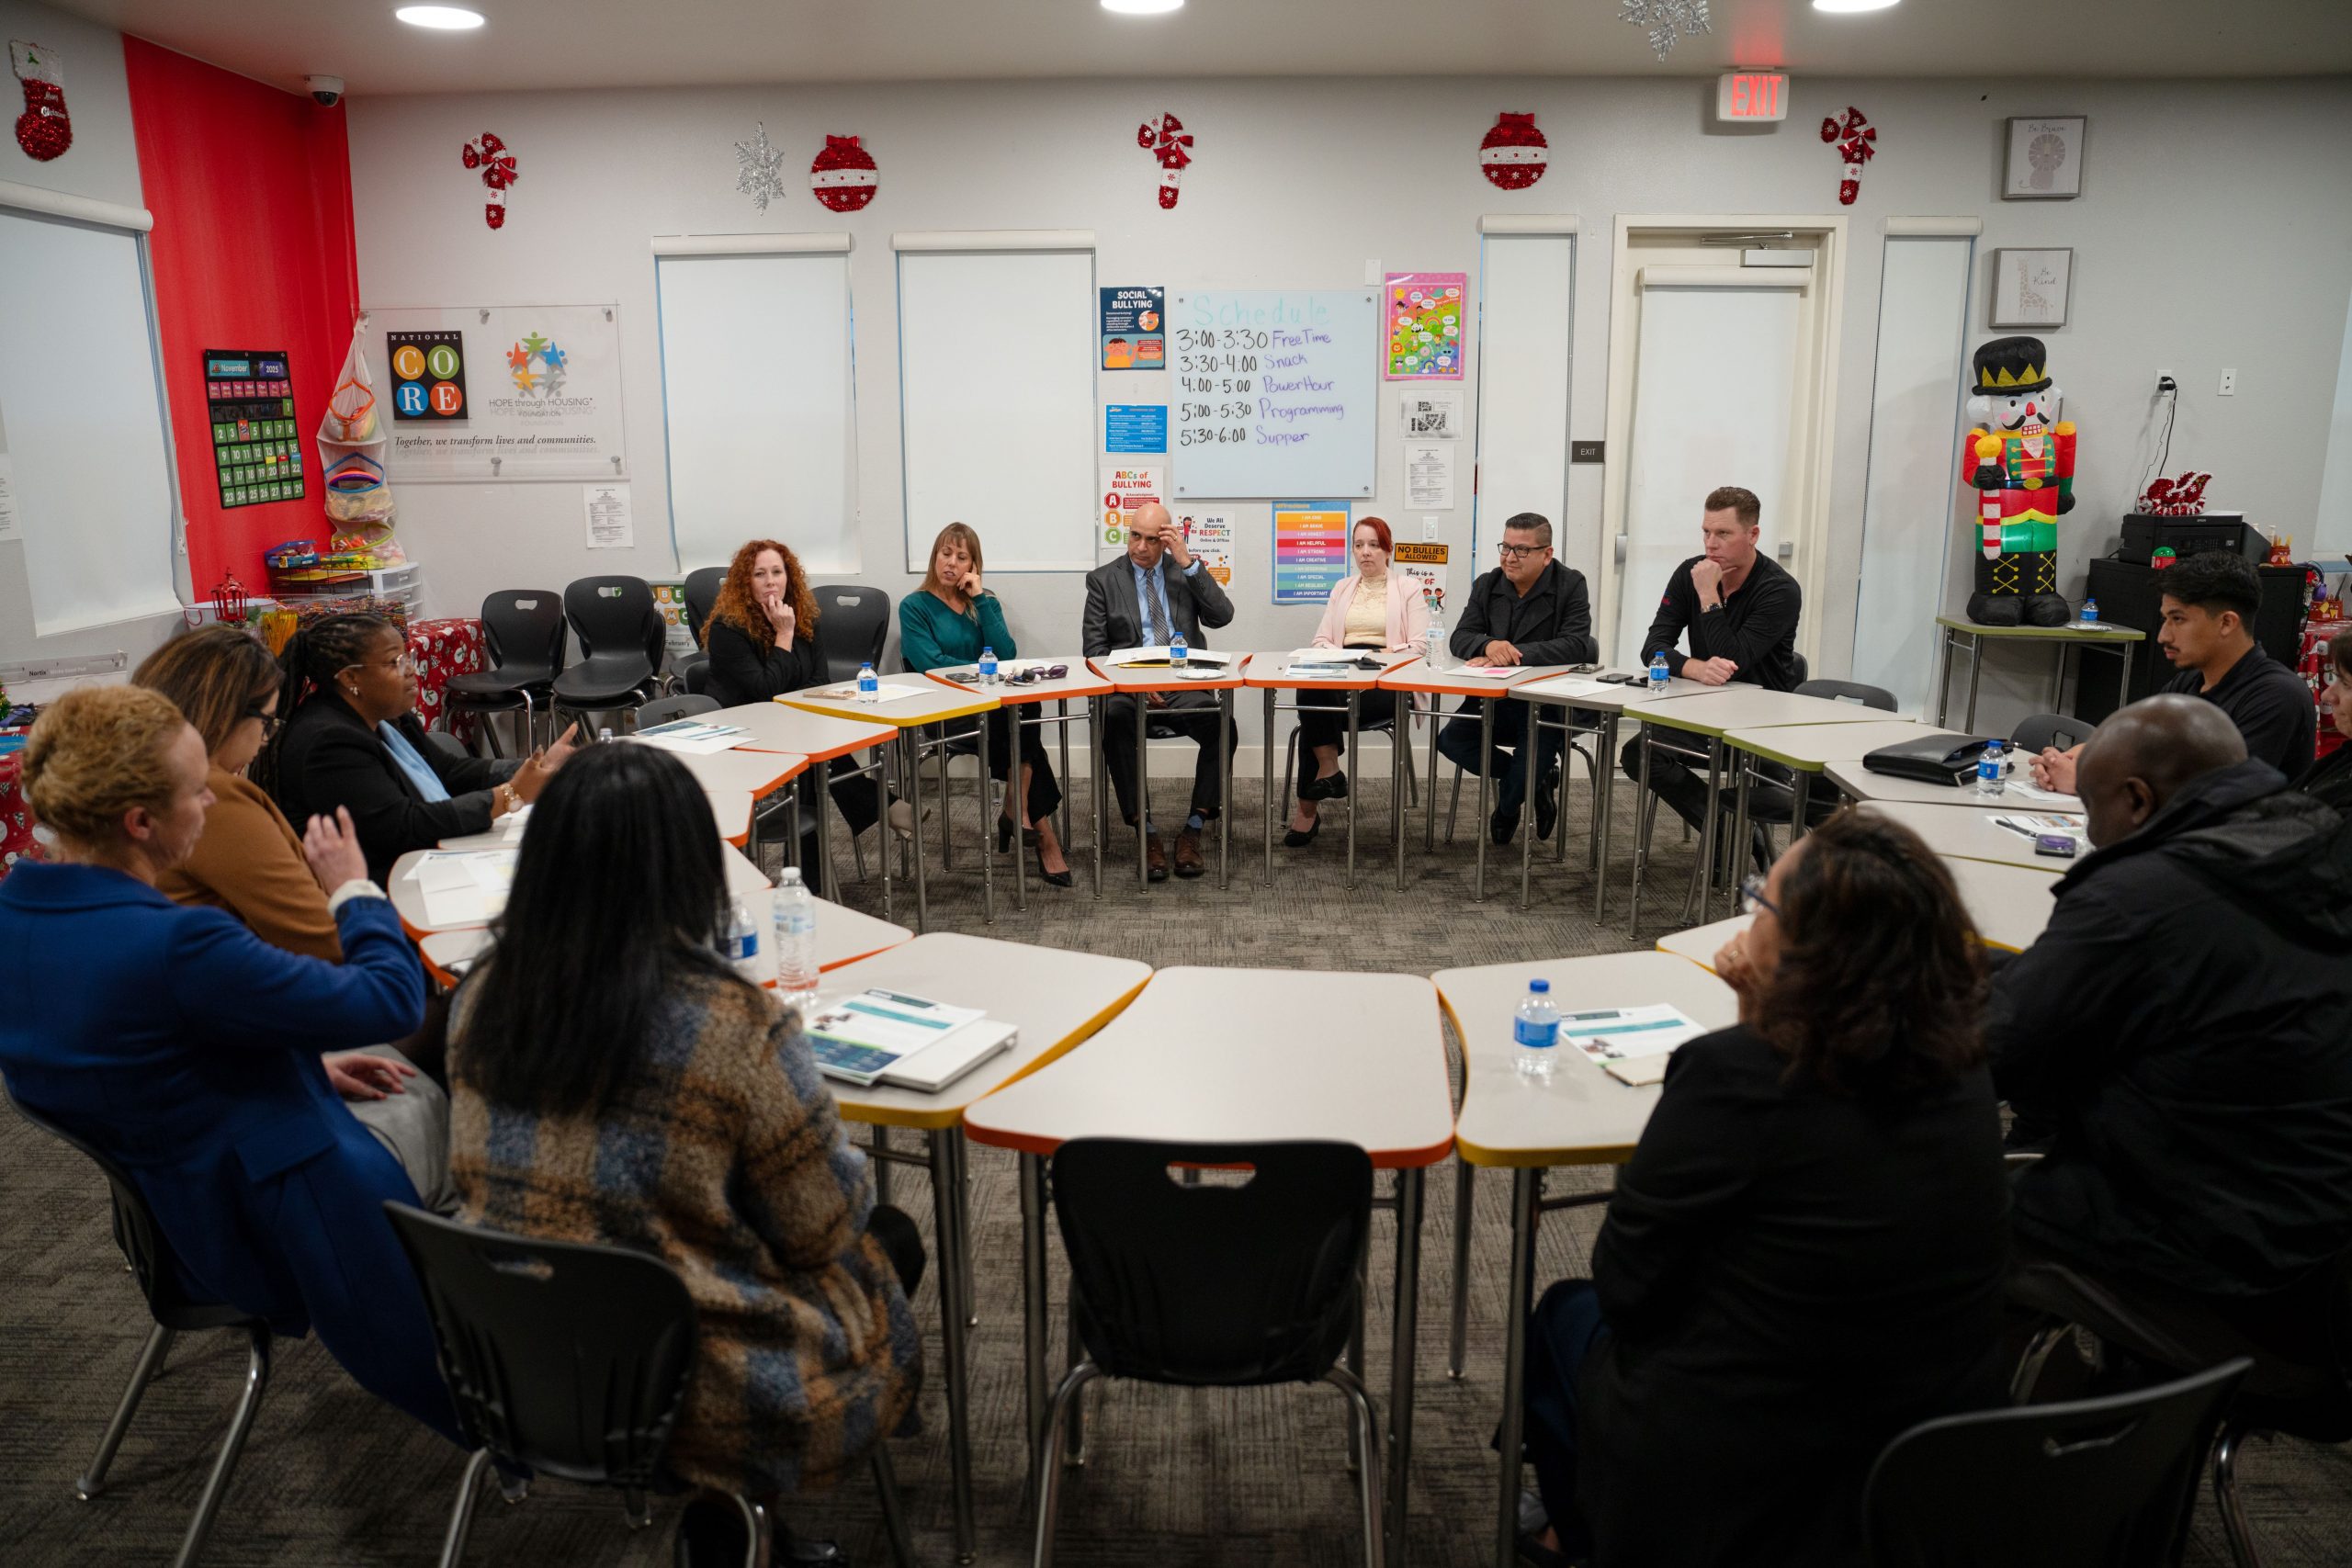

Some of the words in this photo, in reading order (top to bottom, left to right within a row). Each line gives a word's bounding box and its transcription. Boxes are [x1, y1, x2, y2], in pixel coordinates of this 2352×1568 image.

[1731, 75, 1782, 117] EXIT
[1117, 291, 1147, 299] SOCIAL
[1112, 300, 1152, 309] BULLYING
[1194, 295, 1329, 325] Schedule
[1264, 354, 1308, 368] Snack
[221, 364, 247, 373] November
[489, 399, 513, 407] HOPE
[514, 398, 546, 408] through
[1259, 398, 1344, 423] Programming
[219, 430, 223, 438] 2
[231, 429, 234, 437] 3
[254, 427, 257, 435] 5
[266, 426, 270, 434] 6
[277, 425, 281, 434] 7
[288, 424, 292, 433] 8
[1256, 425, 1309, 446] Supper
[395, 436, 433, 448] Together,
[450, 436, 493, 447] transform
[496, 435, 514, 445] lives
[517, 435, 535, 445] and
[537, 435, 595, 445] communities.
[222, 452, 226, 460] 9
[233, 451, 240, 459] 10
[243, 450, 250, 458] 11
[254, 448, 261, 457] 12
[266, 447, 272, 456] 13
[278, 446, 285, 454] 14
[223, 473, 230, 481] 16
[236, 471, 243, 479] 17
[248, 470, 254, 479] 18
[258, 469, 265, 478] 19
[269, 467, 276, 476] 20
[282, 466, 288, 474] 21
[226, 493, 233, 502] 23
[238, 491, 245, 500] 24
[250, 491, 257, 499] 25
[261, 490, 267, 498] 26
[272, 488, 278, 496] 27
[284, 486, 290, 494] 28
[296, 484, 302, 493] 29
[1109, 495, 1117, 505] A
[1110, 513, 1117, 524] B
[1109, 531, 1116, 541] C
[1413, 547, 1445, 555] BULLIES
[1406, 568, 1419, 576] This
